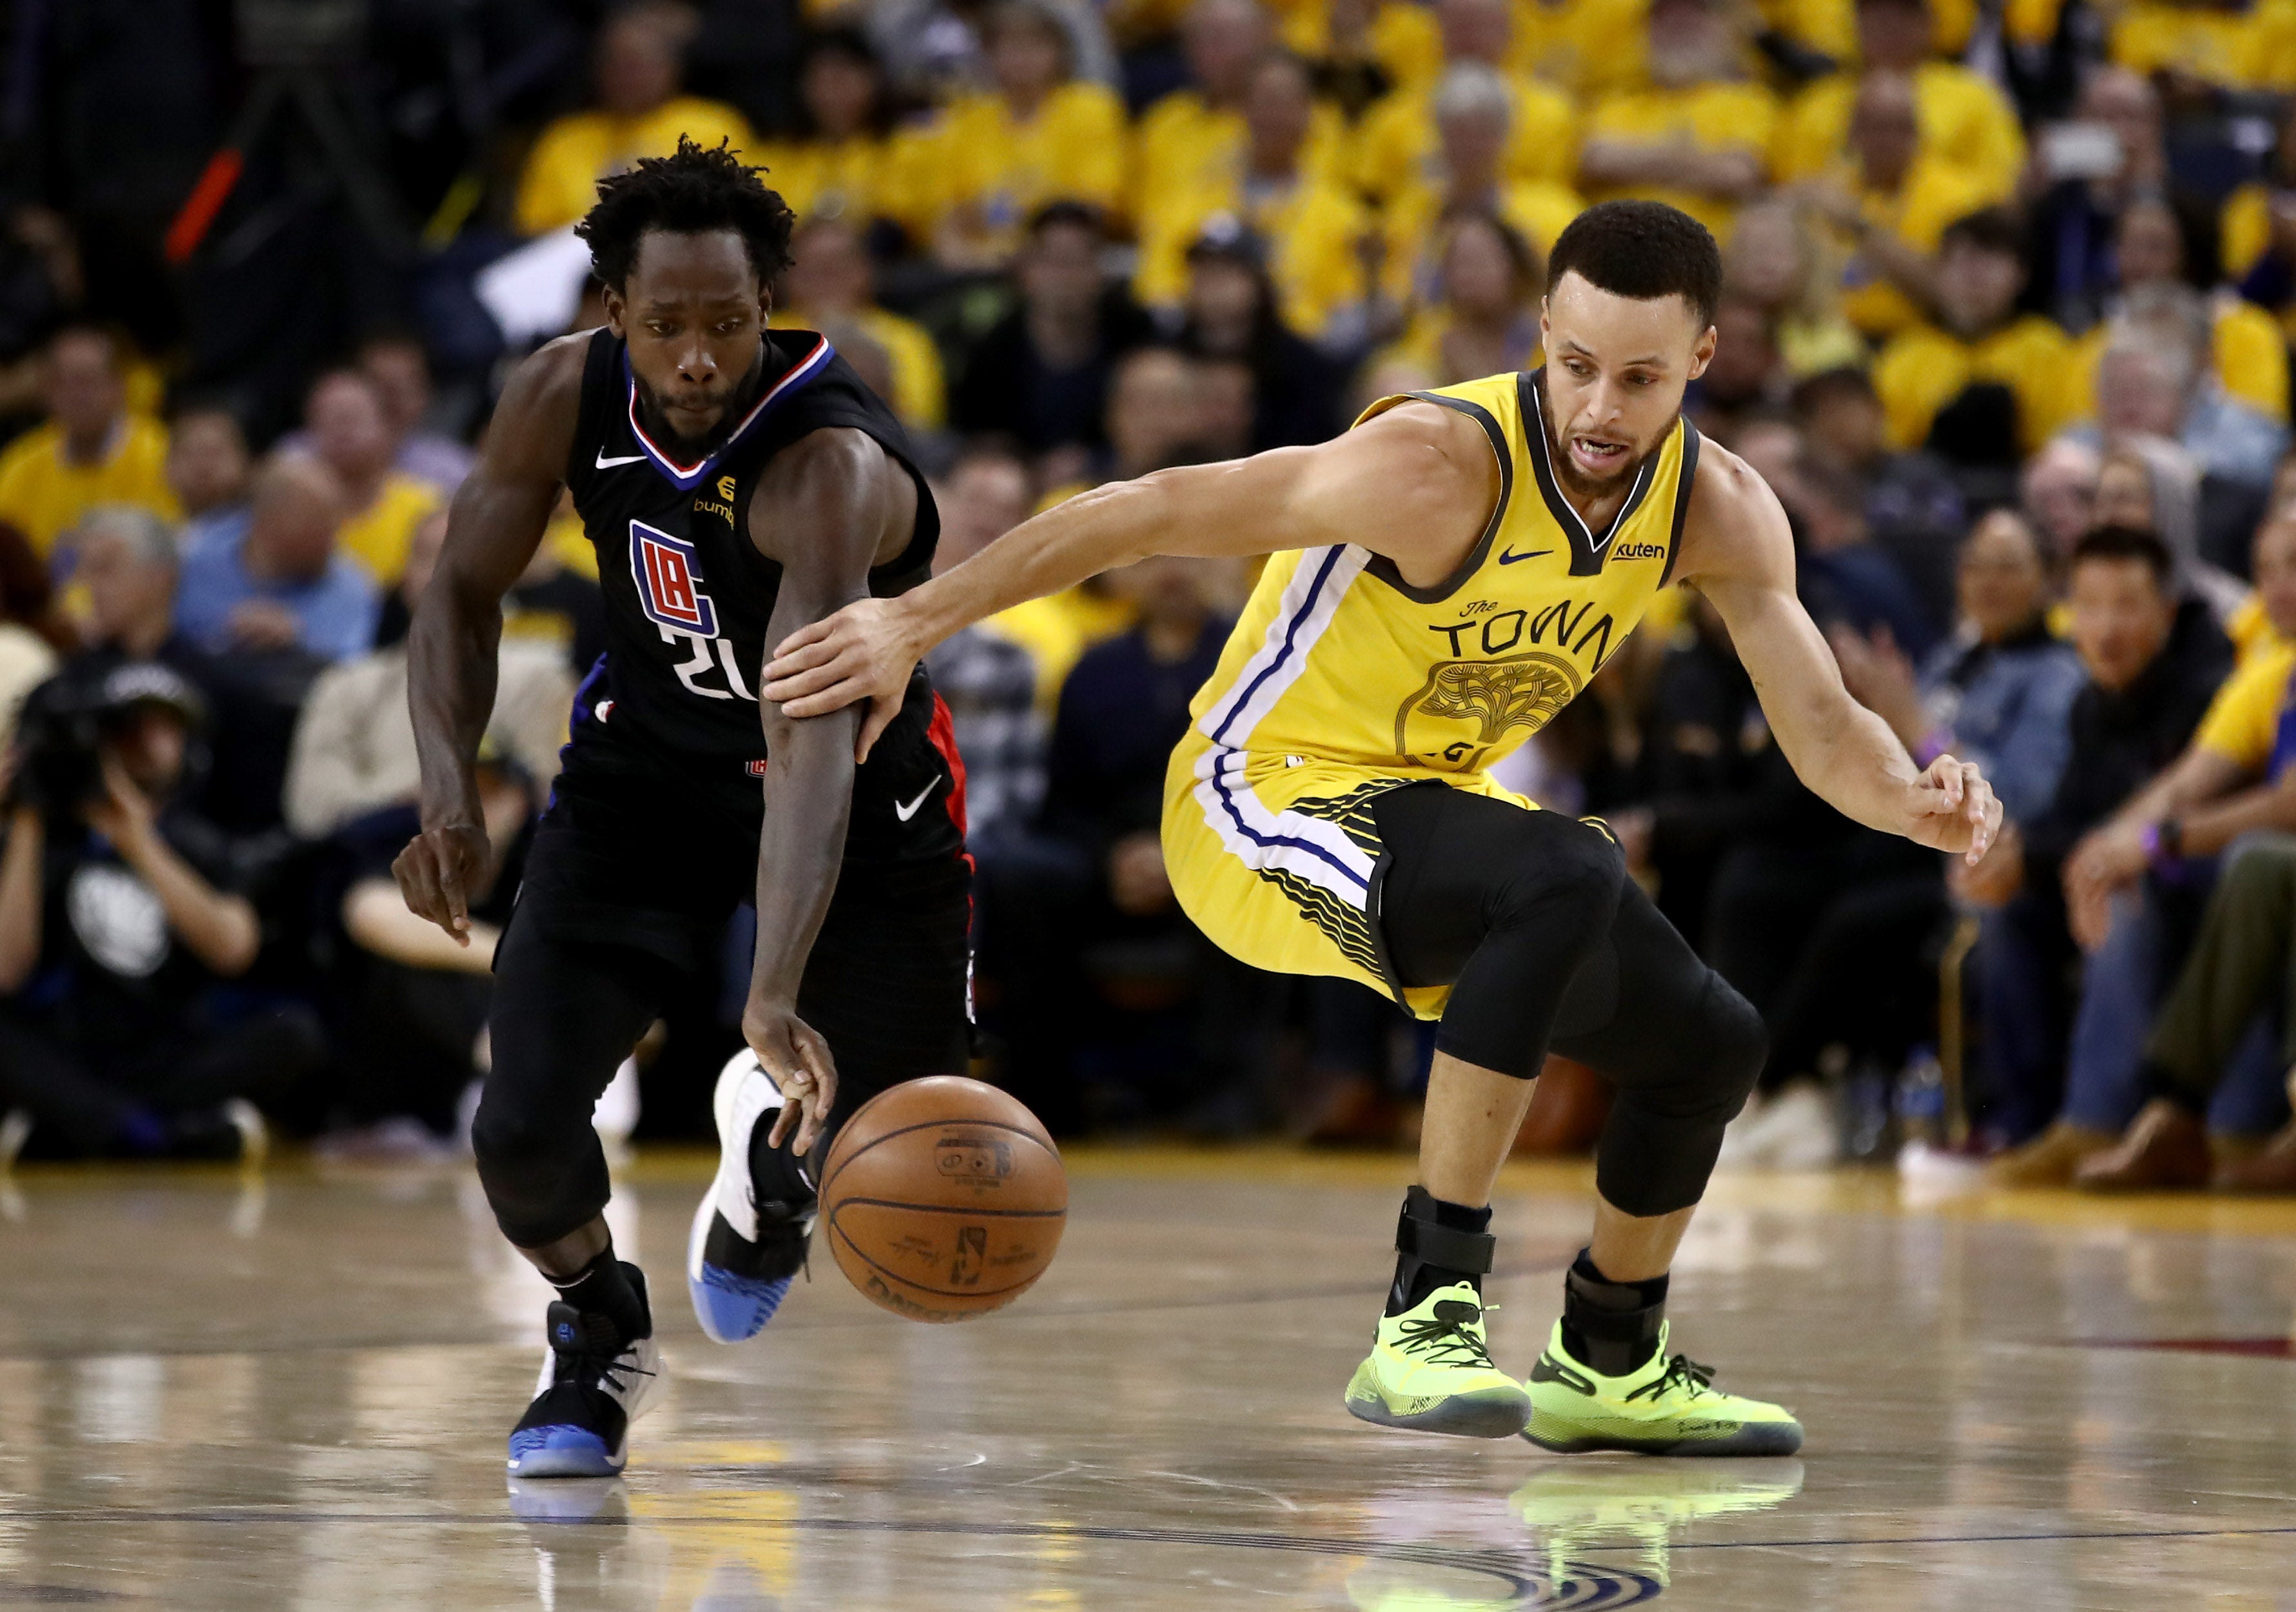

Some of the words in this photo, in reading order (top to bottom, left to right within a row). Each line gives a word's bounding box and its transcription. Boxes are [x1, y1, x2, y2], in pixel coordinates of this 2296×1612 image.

[1428, 599, 1628, 673] TOWN
[1459, 600, 1498, 617] The
[657, 622, 759, 701] 21
